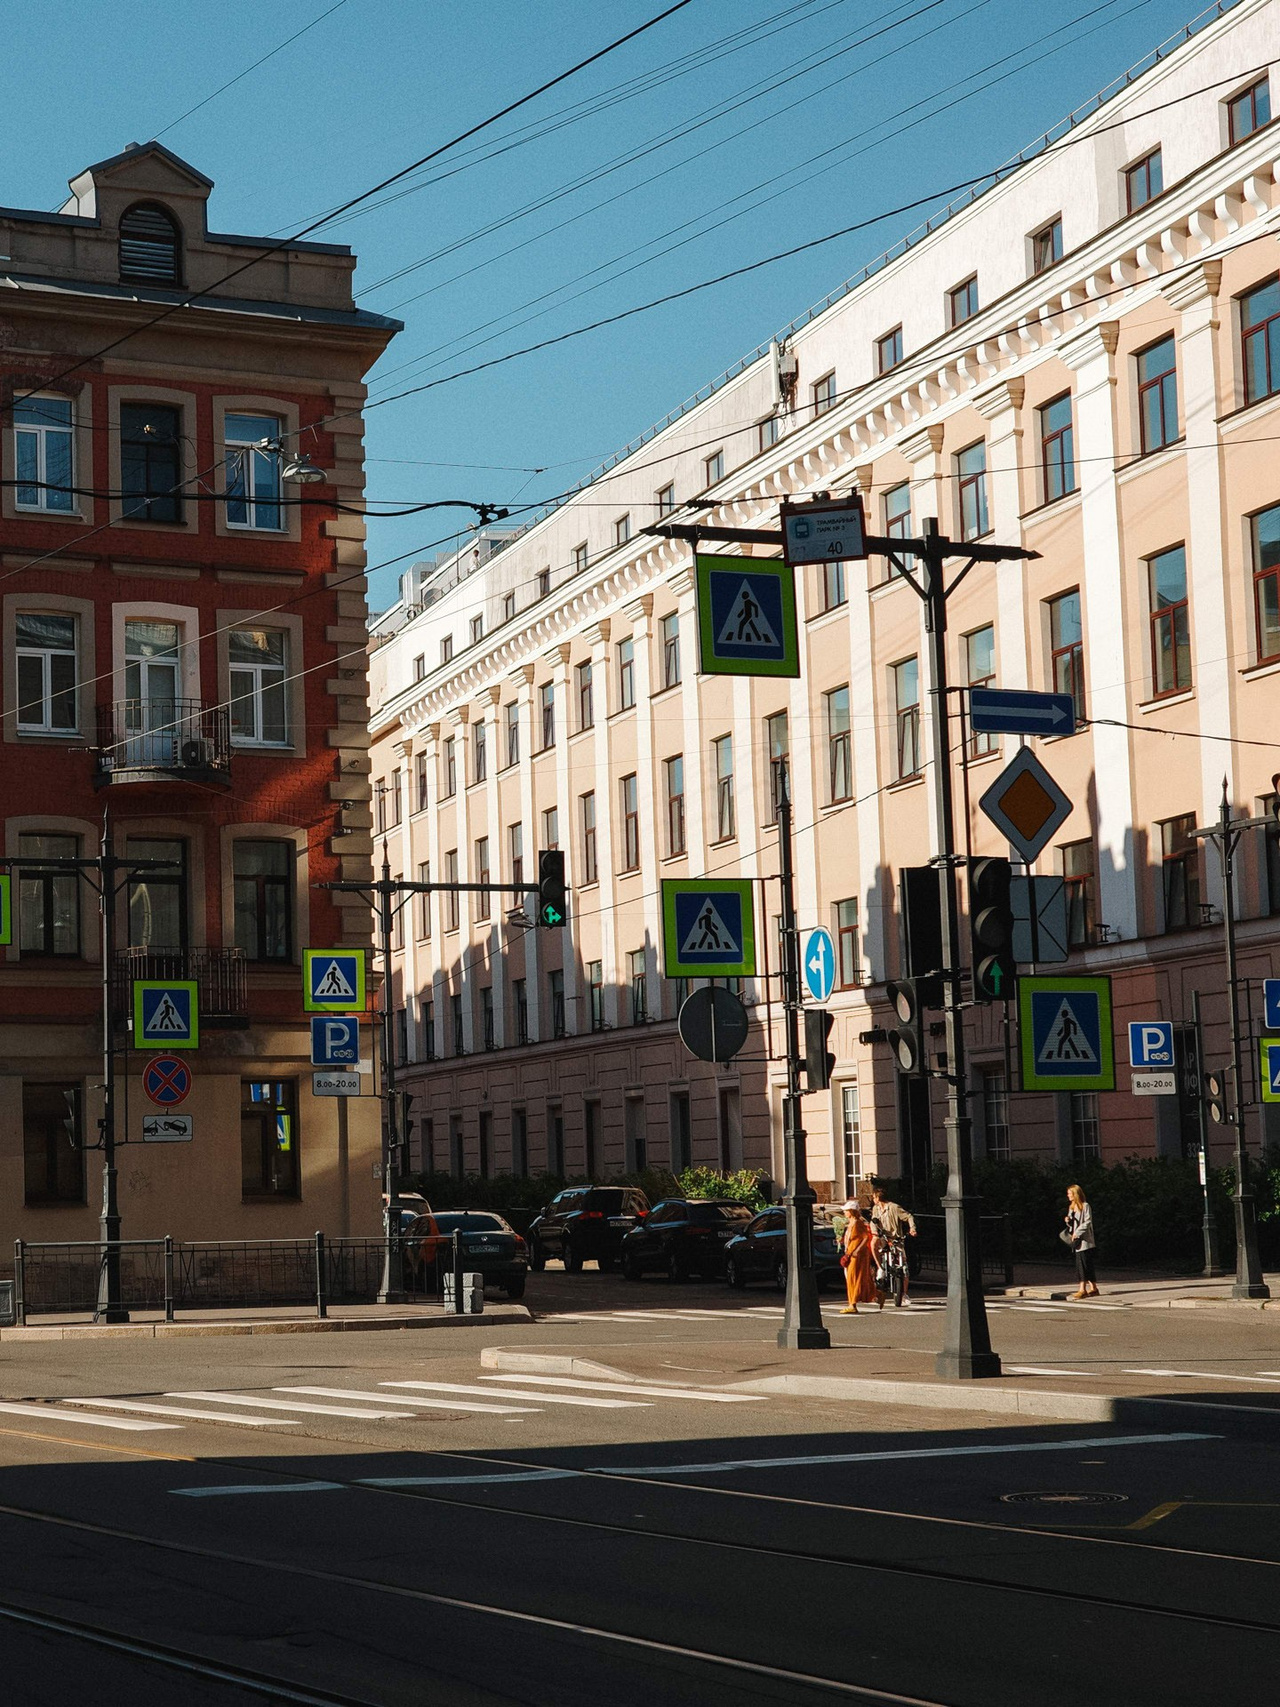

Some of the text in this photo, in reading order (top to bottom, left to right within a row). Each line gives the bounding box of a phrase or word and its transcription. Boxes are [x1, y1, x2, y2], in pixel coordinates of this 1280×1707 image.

[816, 516, 856, 525] ТРАМВАЙНЫЙ
[827, 541, 843, 555] 40
[325, 1022, 350, 1059] P
[1142, 1027, 1165, 1061] P
[316, 1080, 357, 1088] 8.00-20.00
[1136, 1080, 1173, 1088] 8.00-20.00
